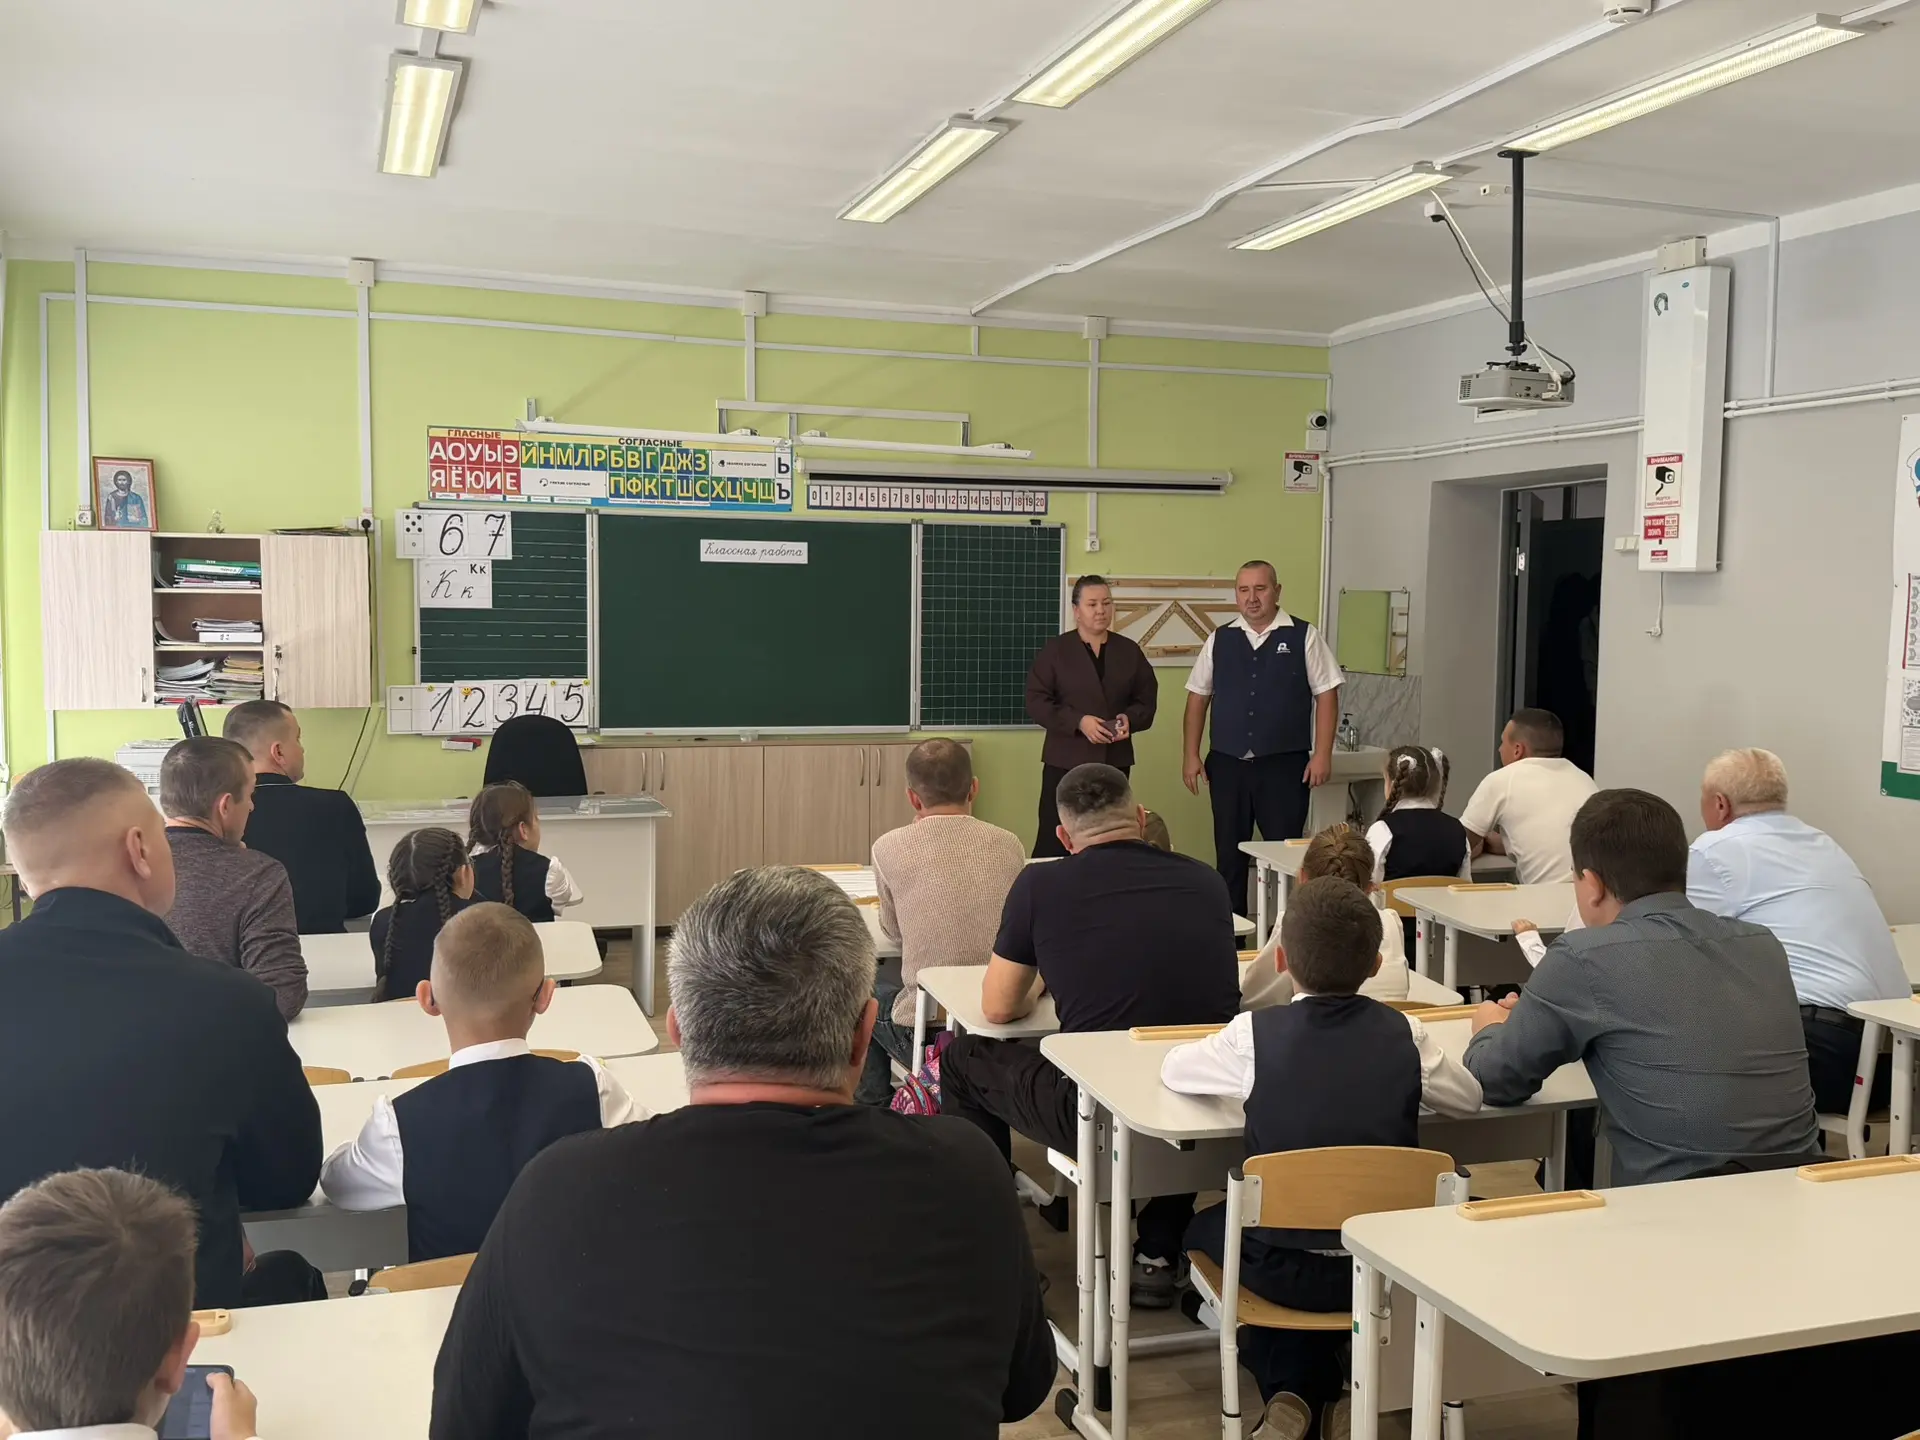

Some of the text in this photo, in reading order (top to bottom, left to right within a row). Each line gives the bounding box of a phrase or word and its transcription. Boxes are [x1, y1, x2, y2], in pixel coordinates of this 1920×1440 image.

[447, 429, 501, 439] ГЛАСНЫЕ
[618, 438, 683, 448] СОГЛАСНЫЕ
[812, 490, 1044, 507] 0 1 2 3 4 5 6 7 8 9 10 11 12 13 14 15 16 17 18 19 20
[439, 513, 506, 556] 6 7
[704, 542, 804, 561] Классная работа
[429, 682, 584, 731] 1 2 3 4 5
